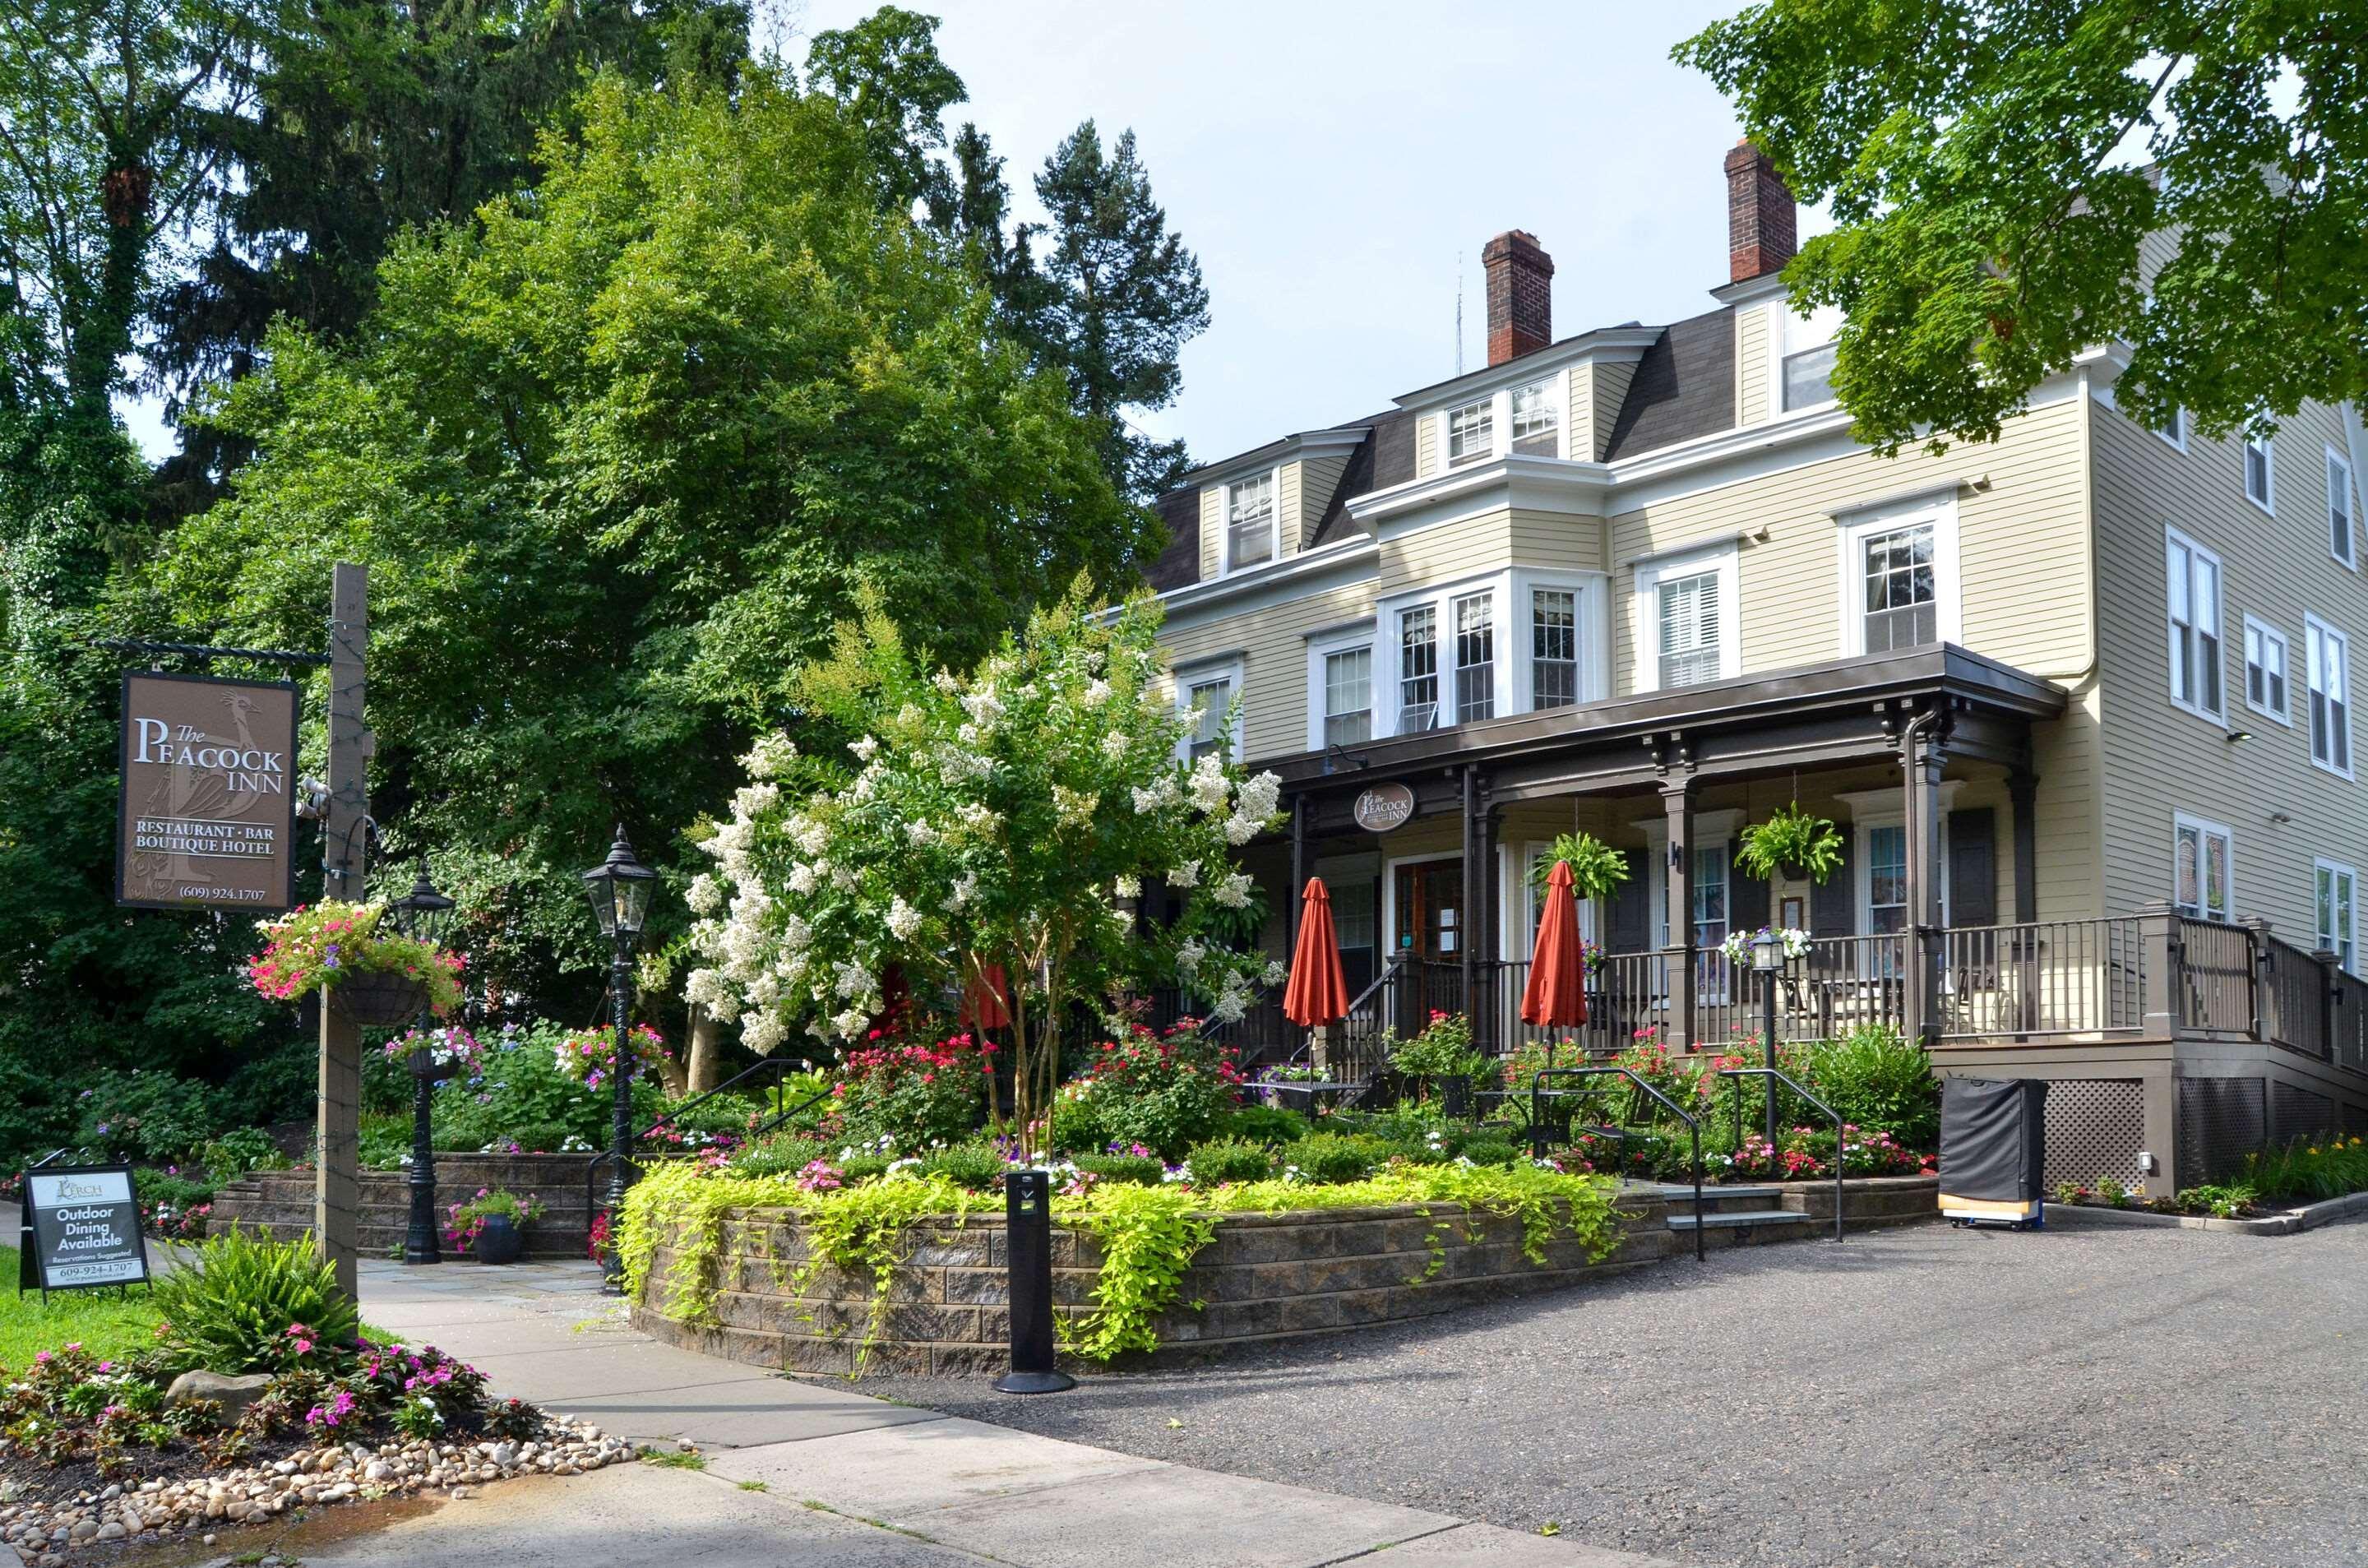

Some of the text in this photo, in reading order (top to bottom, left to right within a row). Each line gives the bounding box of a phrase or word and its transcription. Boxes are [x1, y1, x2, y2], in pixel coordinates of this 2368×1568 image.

[177, 724, 205, 743] The
[133, 718, 284, 773] PEACOCK
[226, 771, 284, 795] INN
[1362, 795, 1408, 815] PEACOCK
[1374, 795, 1385, 803] The
[1389, 809, 1408, 821] INN
[136, 821, 274, 840] RESTAURANT BAR
[136, 835, 274, 855] BOUTIQUE HOTEL
[179, 886, 266, 901] (609) 924.1707
[57, 1206, 113, 1221] Outdoor
[66, 1222, 109, 1237] Dining
[58, 1233, 123, 1251] Available
[53, 1249, 132, 1263] Reservations Suggested
[60, 1263, 132, 1276] 609-924-1707
